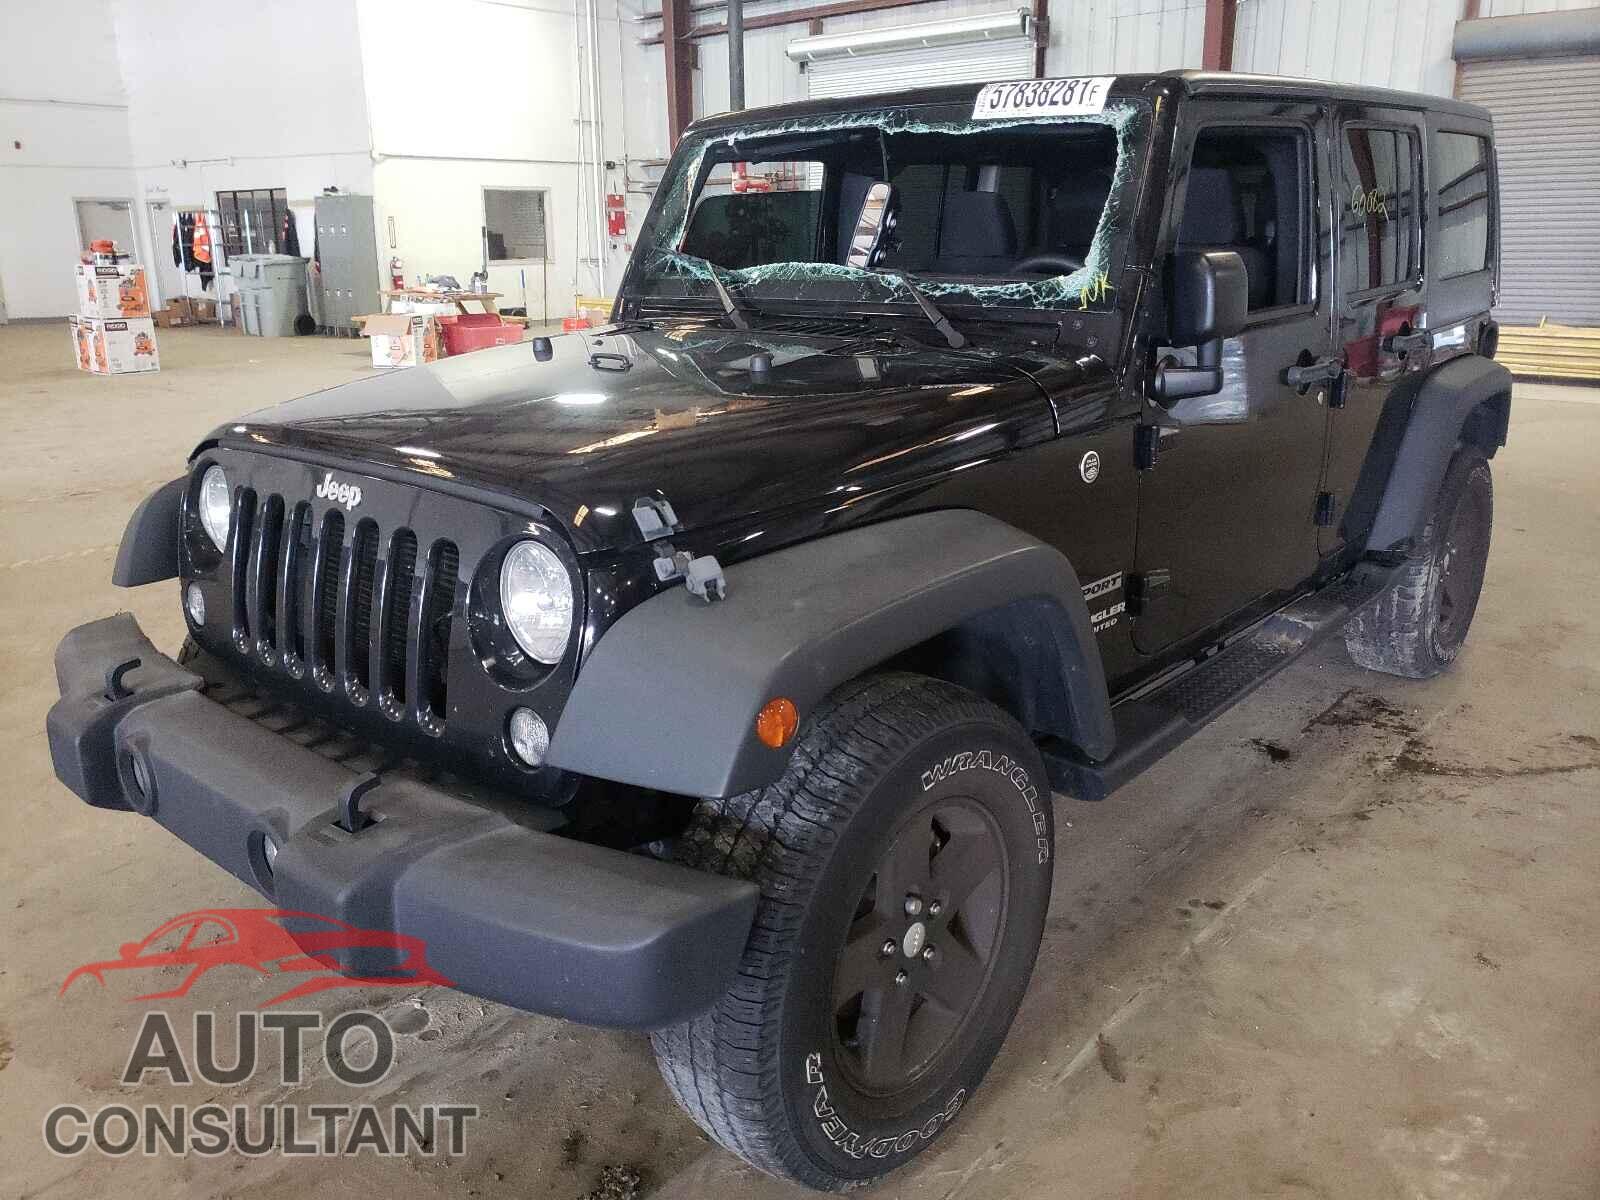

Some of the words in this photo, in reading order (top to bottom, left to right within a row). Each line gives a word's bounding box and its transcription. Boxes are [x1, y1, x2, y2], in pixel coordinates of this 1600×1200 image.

[316, 472, 362, 511] Jeep
[921, 750, 1049, 864] WRANGLER
[805, 1051, 966, 1159] GOODYEAR
